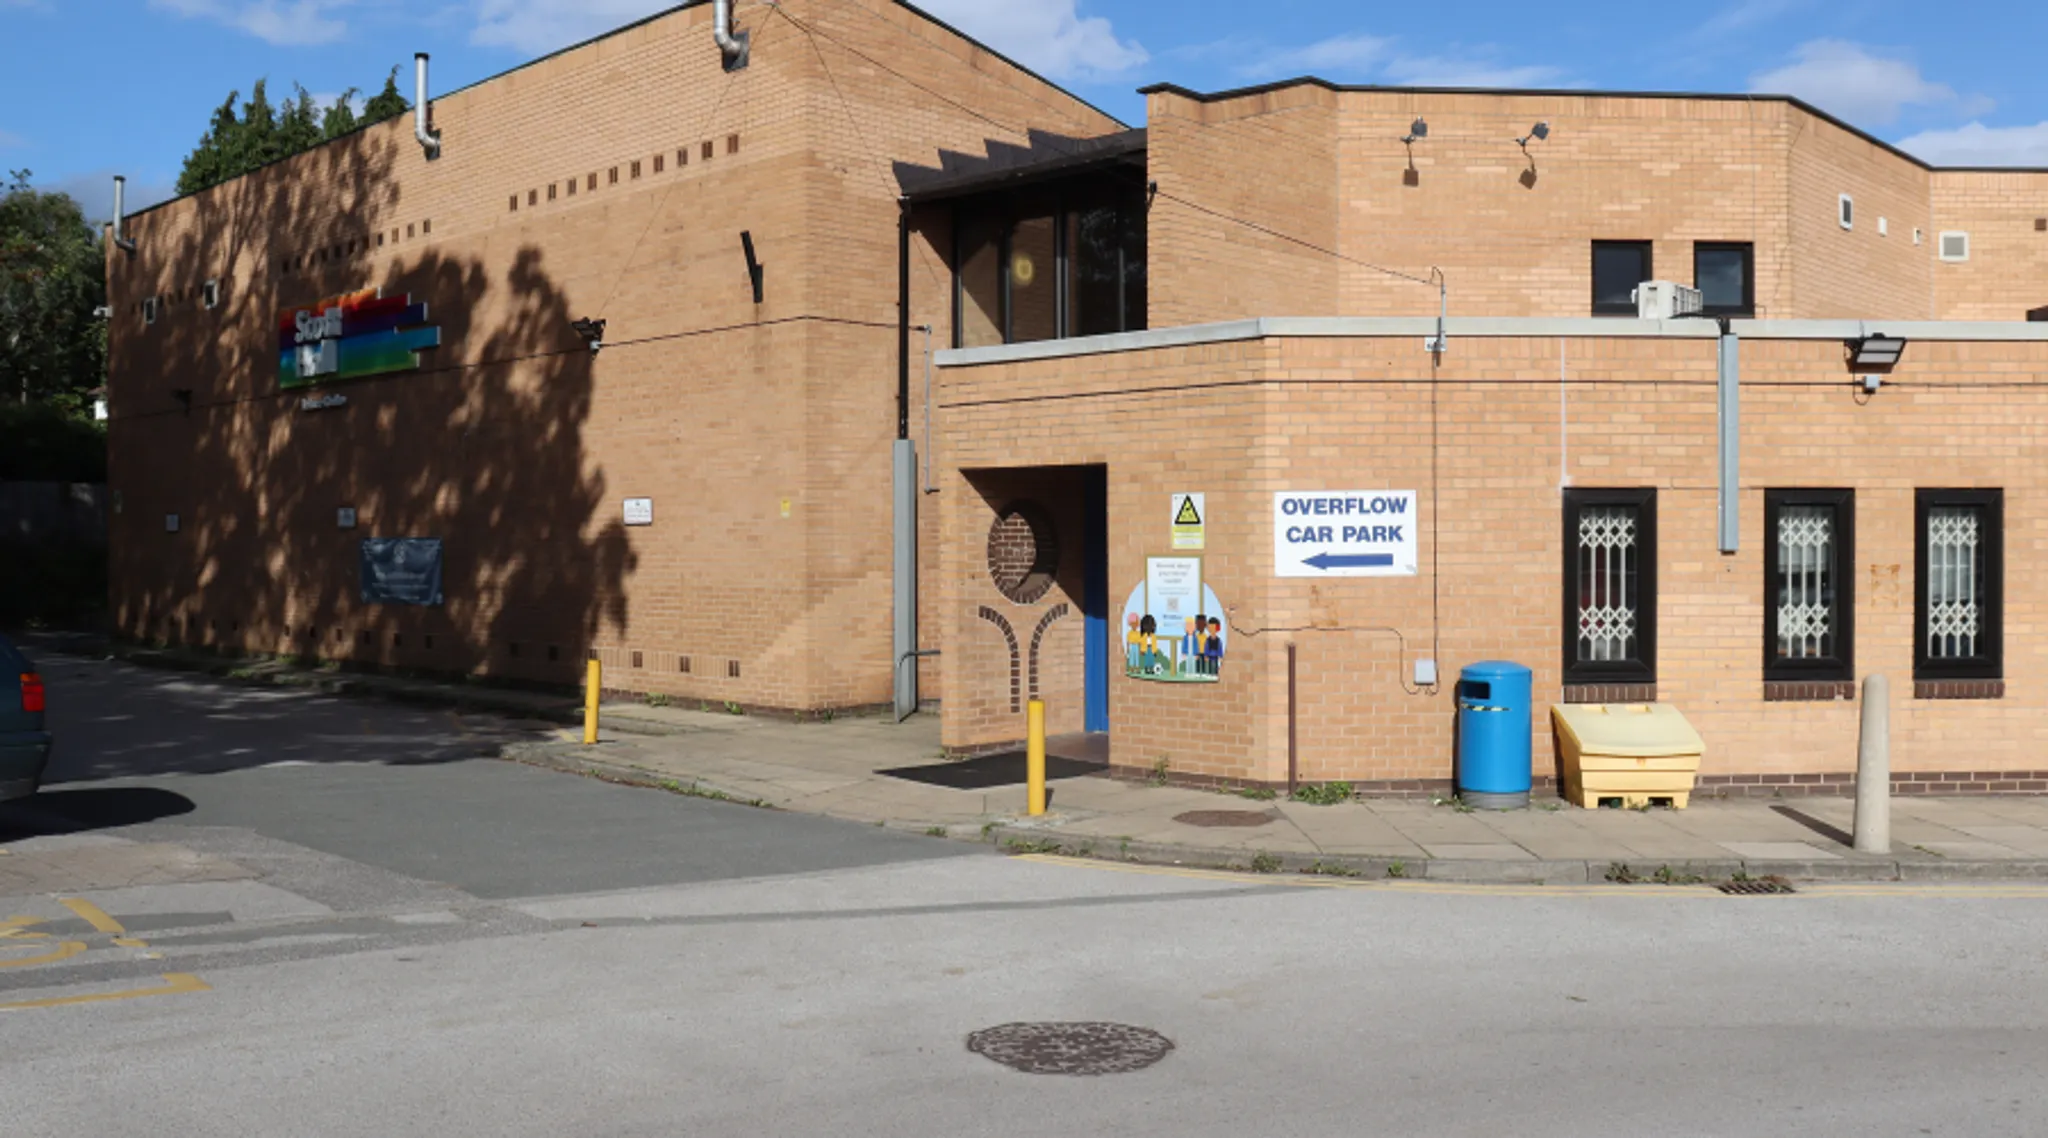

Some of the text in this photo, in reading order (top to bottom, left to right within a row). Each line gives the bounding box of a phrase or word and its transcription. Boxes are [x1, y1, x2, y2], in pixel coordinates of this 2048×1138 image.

[1281, 497, 1407, 515] OVERFLOW
[1286, 525, 1404, 543] CAR PARK
